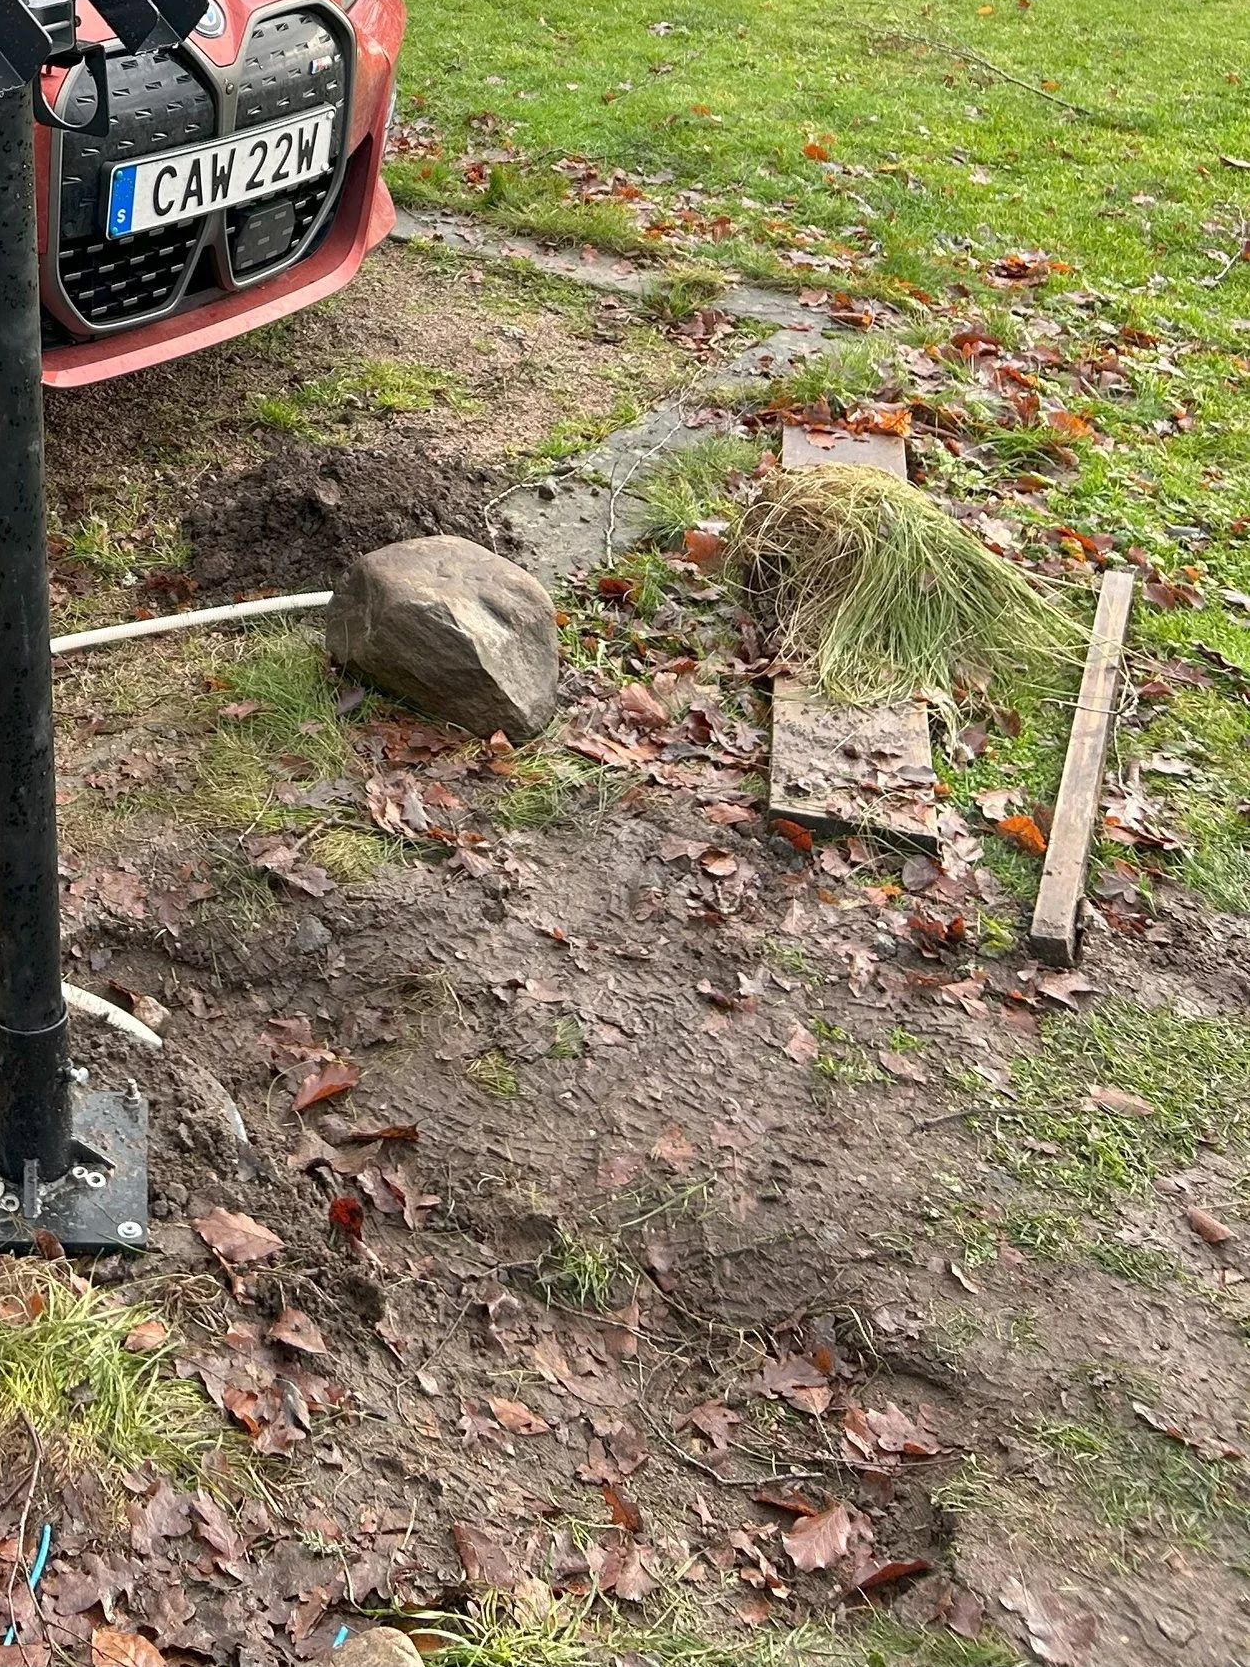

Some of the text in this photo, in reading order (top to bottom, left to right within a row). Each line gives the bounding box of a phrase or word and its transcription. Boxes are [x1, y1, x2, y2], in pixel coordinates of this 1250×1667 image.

[153, 122, 319, 216] CAW 22W
[117, 209, 126, 224] S
